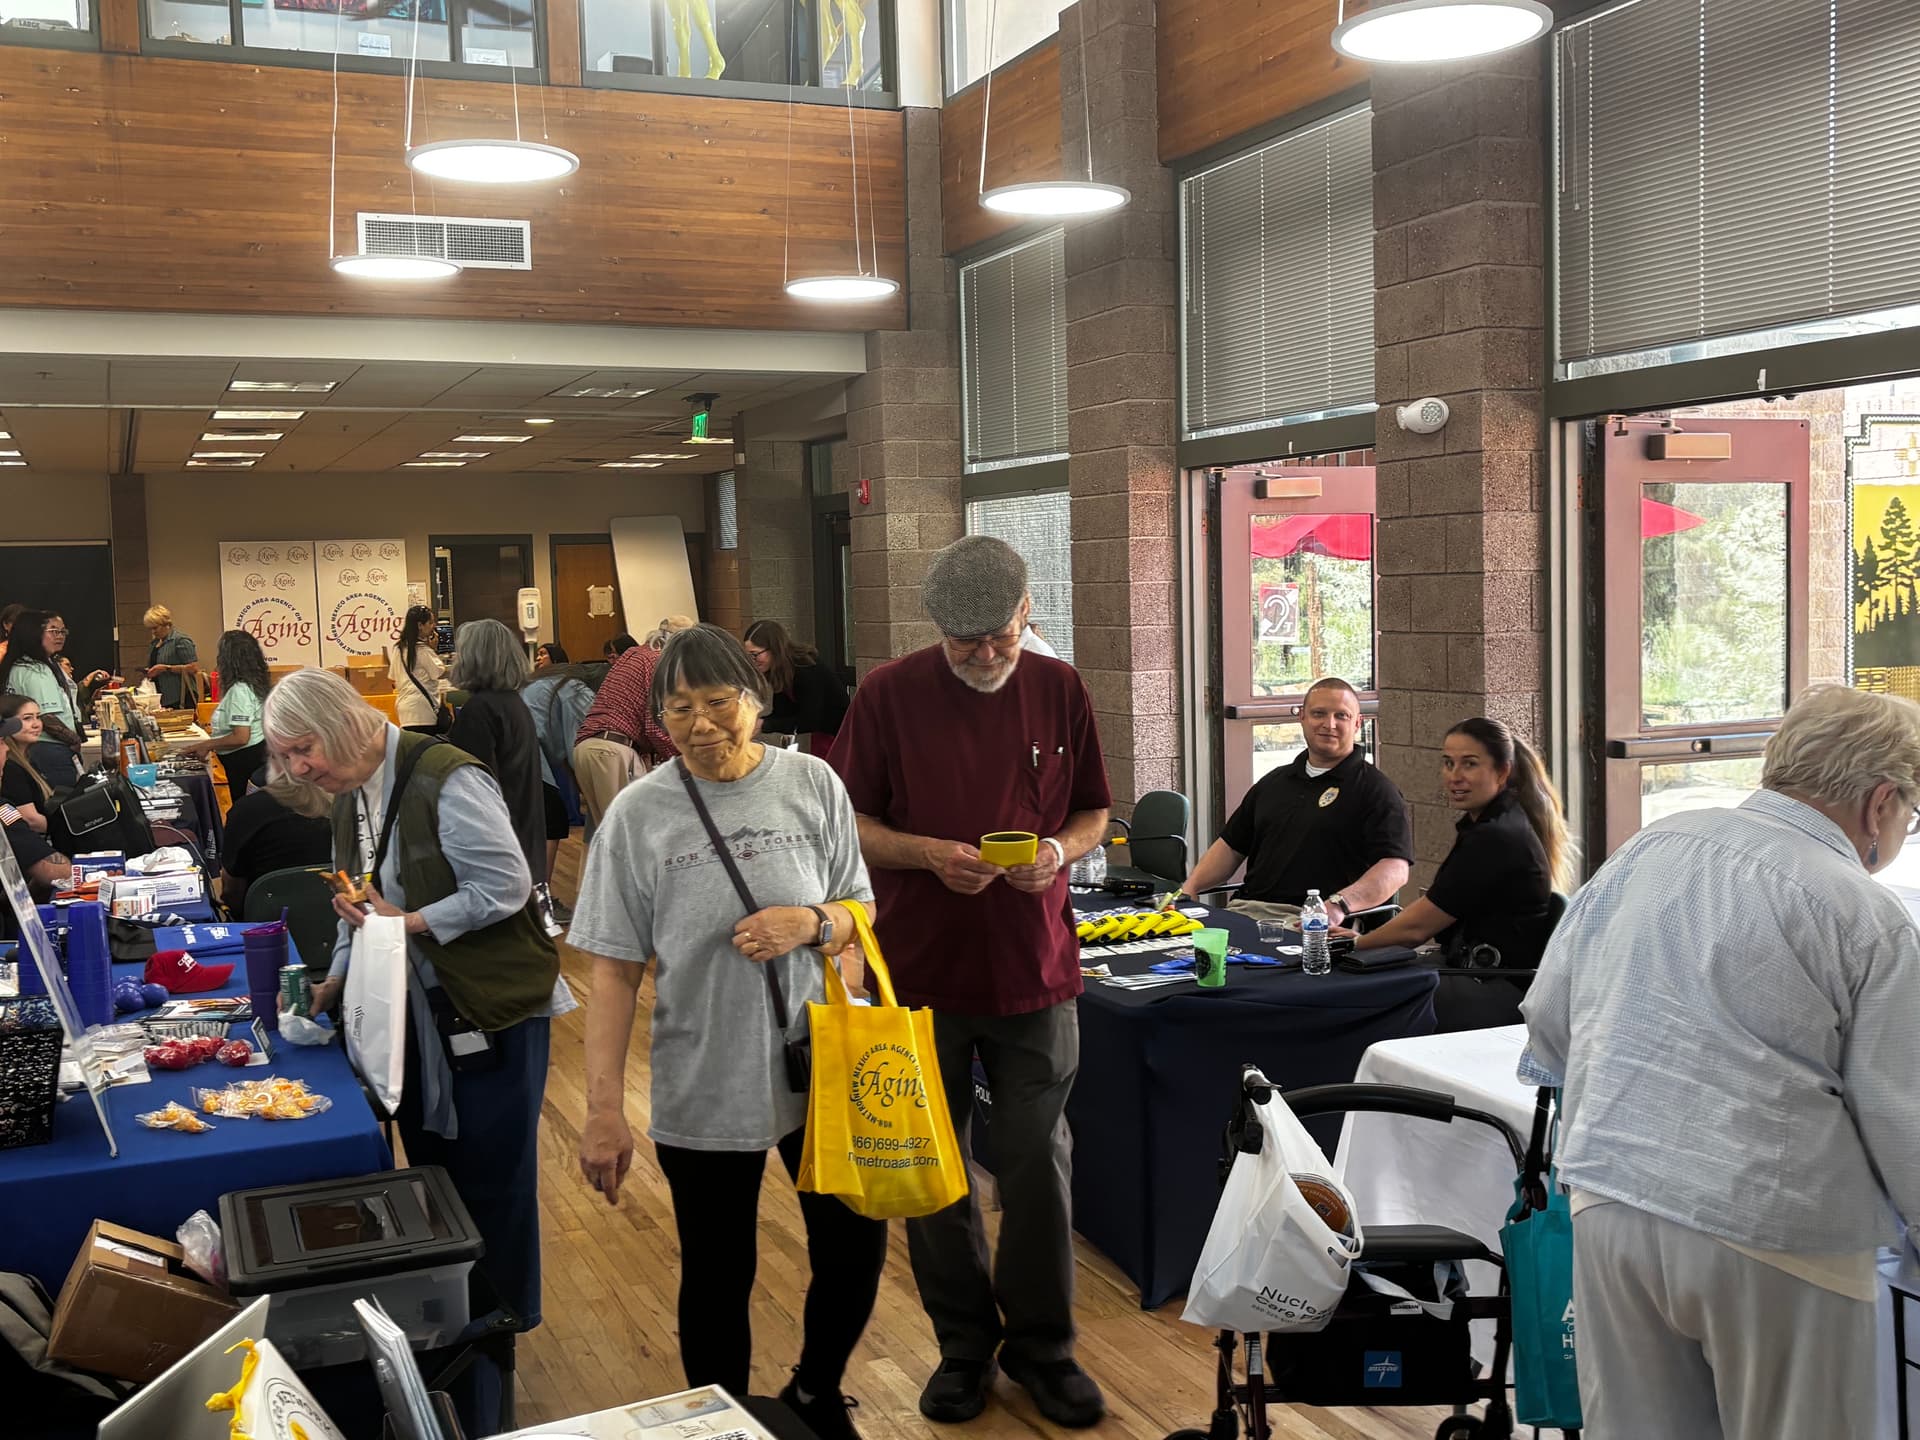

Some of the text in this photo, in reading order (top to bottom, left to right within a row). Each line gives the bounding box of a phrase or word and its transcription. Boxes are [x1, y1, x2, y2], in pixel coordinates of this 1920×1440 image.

[236, 605, 251, 627] MEXICO
[252, 597, 269, 606] AREA
[271, 597, 296, 611] AGENCY
[331, 600, 346, 622] MEXICO
[346, 592, 363, 601] AREA
[364, 592, 388, 606] AGENCY
[242, 610, 313, 647] Aging
[326, 605, 404, 642] Aging
[853, 1051, 870, 1078] MEXICO
[849, 1061, 929, 1108] Aging
[1255, 1295, 1296, 1319] Care
